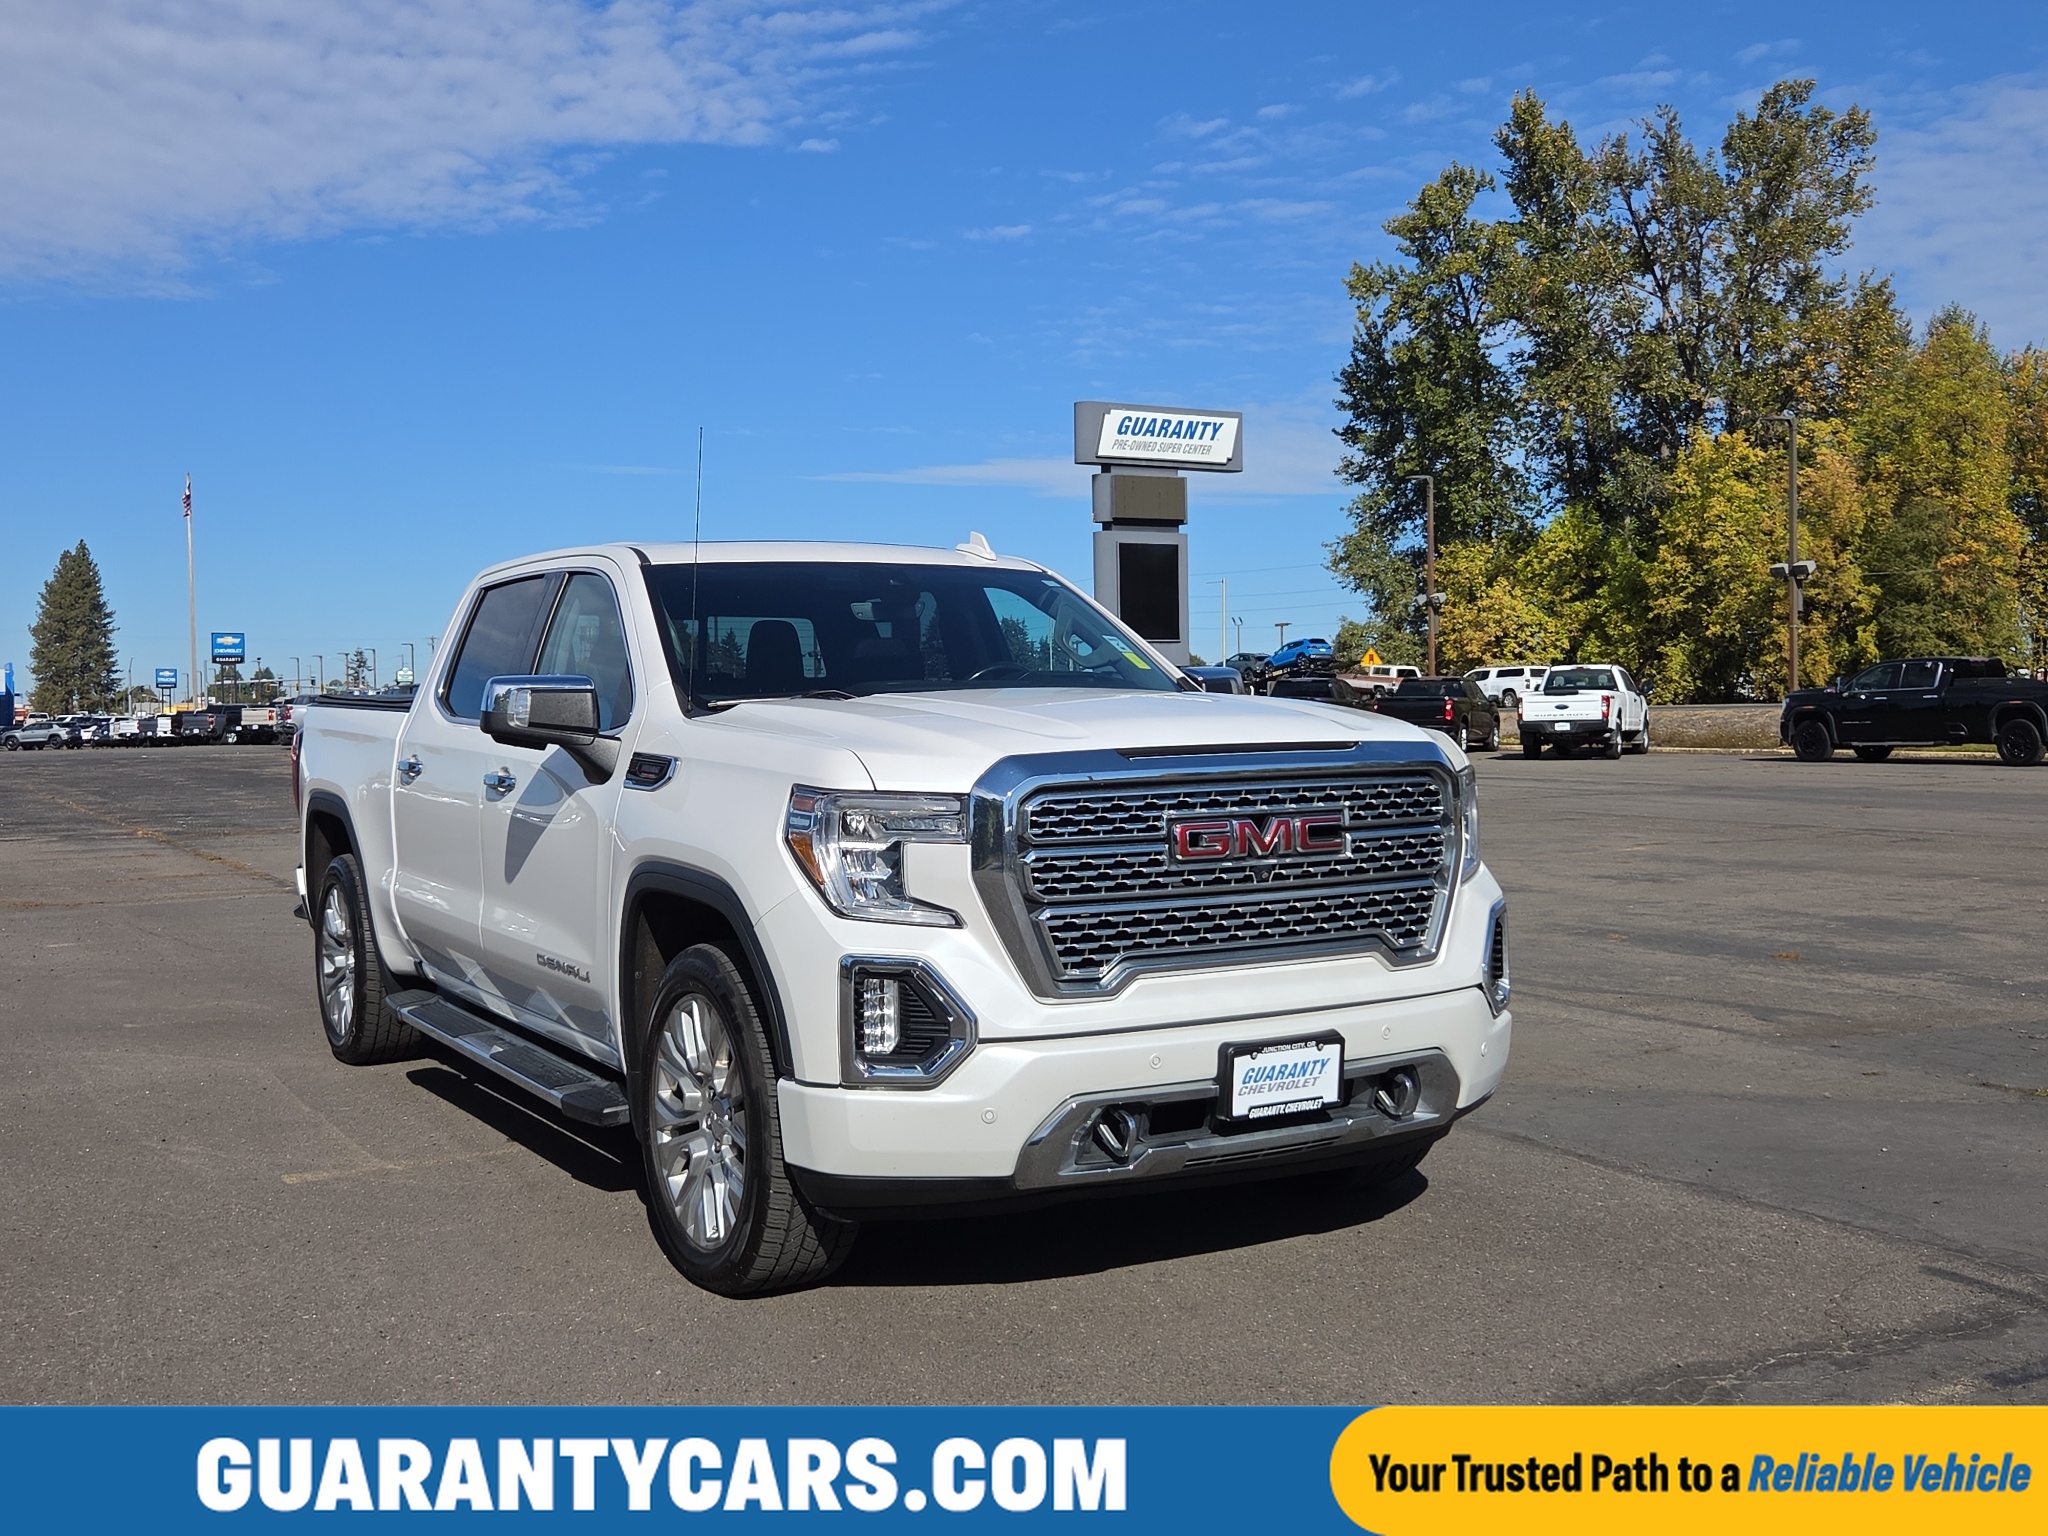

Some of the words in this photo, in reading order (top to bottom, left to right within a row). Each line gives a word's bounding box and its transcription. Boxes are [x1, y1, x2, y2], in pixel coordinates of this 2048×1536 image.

[1116, 415, 1224, 441] GUARANTY
[1112, 439, 1158, 453] PRE-OWNED
[1157, 441, 1182, 454] SUPER
[1183, 443, 1213, 456] CENTER
[1174, 815, 1344, 861] GMC
[536, 953, 591, 983] DENALI
[1261, 1044, 1291, 1054] JUNCTION
[1306, 1040, 1317, 1048] OR
[1242, 1058, 1331, 1085] GUARANTY
[1237, 1076, 1321, 1096] CHEVROLET
[1249, 1104, 1286, 1119] GUARANTY
[1285, 1098, 1324, 1113] CHEVROLET
